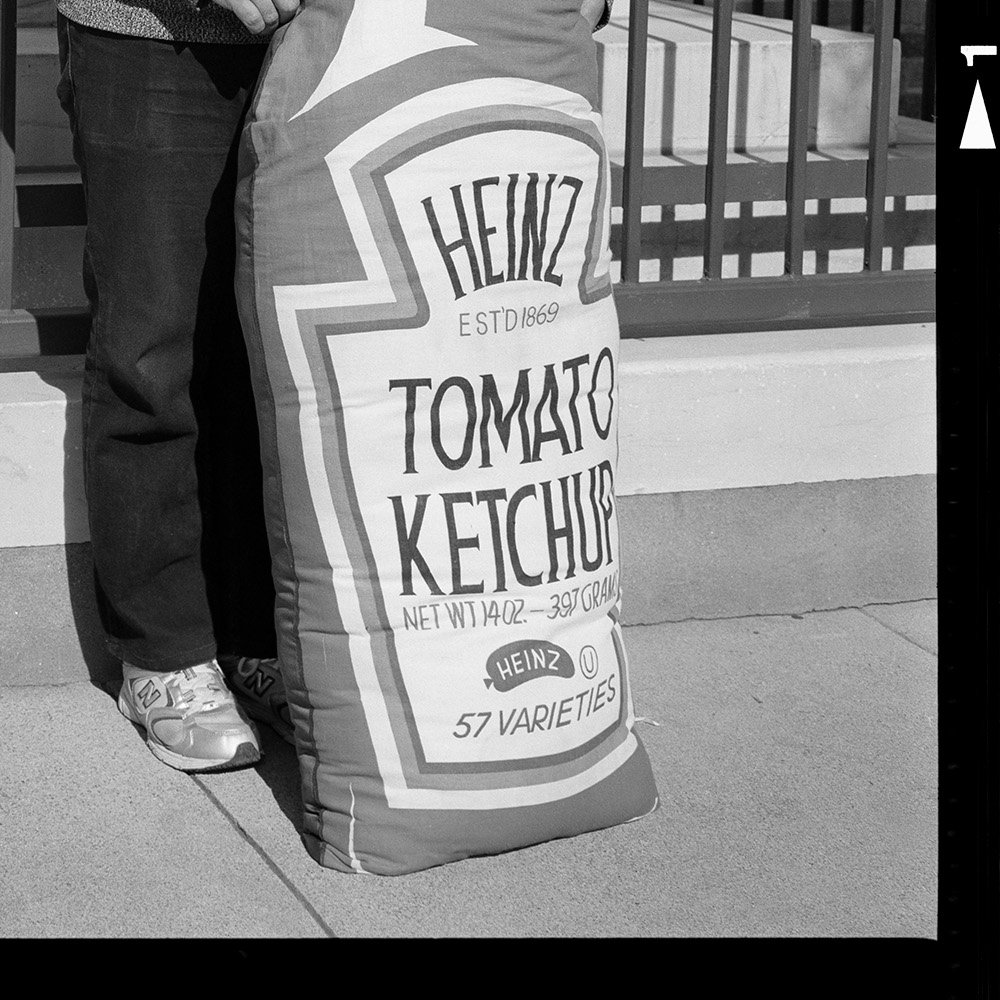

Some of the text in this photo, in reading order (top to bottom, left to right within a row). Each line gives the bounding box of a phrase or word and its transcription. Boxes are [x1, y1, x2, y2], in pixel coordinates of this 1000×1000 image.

[420, 172, 583, 301] HEINZ
[459, 301, 560, 336] EST'D 1869
[388, 347, 614, 475] TOMATO
[387, 460, 614, 596] KETCHUP
[403, 603, 440, 631] NET
[444, 600, 476, 629] WT
[547, 587, 580, 619] 397
[496, 648, 561, 681] HEINZ
[452, 673, 616, 738] 57 VARIETIES
